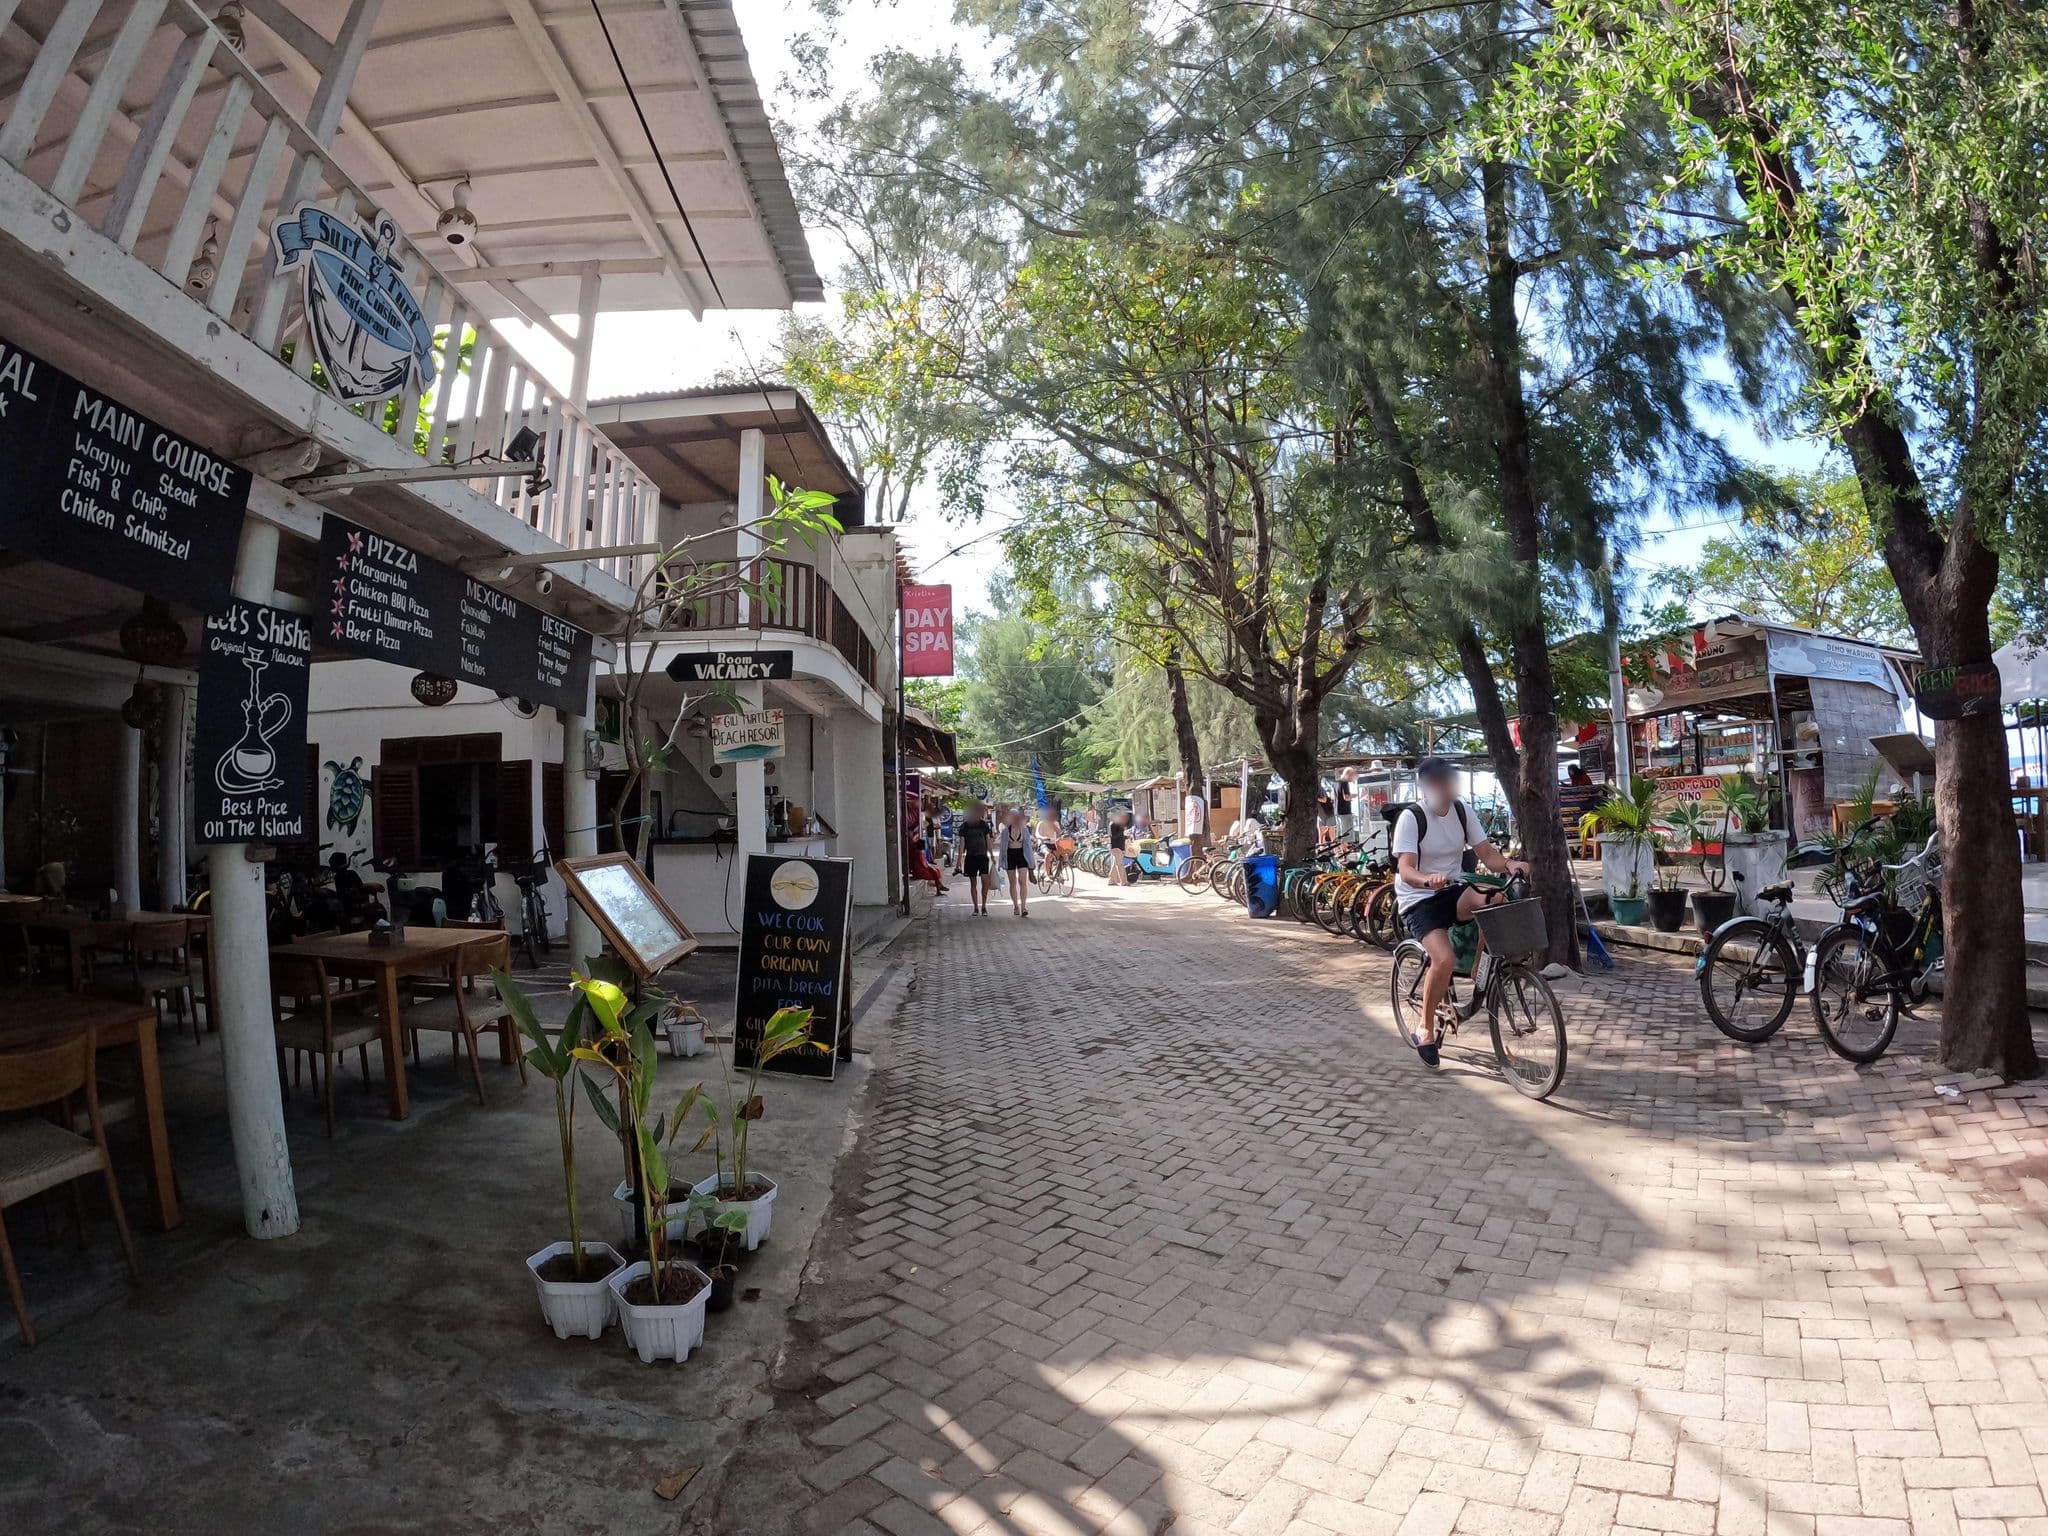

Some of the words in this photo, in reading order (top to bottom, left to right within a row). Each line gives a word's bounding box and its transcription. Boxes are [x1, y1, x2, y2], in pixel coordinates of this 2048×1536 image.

[319, 215, 362, 260] Surf
[368, 256, 384, 283] &
[388, 273, 421, 326] Turf
[337, 283, 389, 341] Restaurant
[340, 265, 364, 296] Fine
[366, 289, 402, 331] Cuisine
[73, 389, 145, 451] MAIN
[152, 433, 235, 498] COURSE
[67, 458, 101, 492] Fish
[111, 478, 120, 501] &
[75, 432, 131, 477] Wagyu
[159, 473, 198, 508] Steak
[61, 488, 115, 530] Chiken
[124, 514, 191, 561] Schnitzel
[367, 534, 418, 575] PIZZA
[351, 556, 408, 590] Margaritha
[350, 578, 389, 605] Chicken
[391, 592, 407, 613] BBQ
[408, 597, 430, 618] Pizza
[466, 578, 517, 619] MEXICAN
[257, 607, 311, 651] Shisha
[348, 600, 382, 624] Frutti
[413, 620, 433, 639] Pizza
[542, 616, 577, 645] DESERT
[905, 607, 950, 628] DAY
[345, 620, 373, 643] Beef
[376, 628, 401, 651] Pizza
[461, 637, 480, 656] Taco
[905, 631, 950, 652] SPA
[460, 657, 486, 677] Nachos
[694, 663, 774, 680] VACANCY
[717, 653, 752, 664] Room
[740, 710, 771, 724] TURTLE
[713, 728, 747, 746] BEACH
[748, 723, 783, 742] RESORT
[221, 798, 254, 816] Best
[257, 798, 288, 815] Price
[1678, 791, 1702, 801] DINO
[227, 817, 255, 836] The
[260, 815, 302, 836] Island
[758, 911, 782, 928] WE
[786, 914, 824, 932] COOK
[764, 934, 791, 950] OUR
[797, 936, 831, 953] OWN
